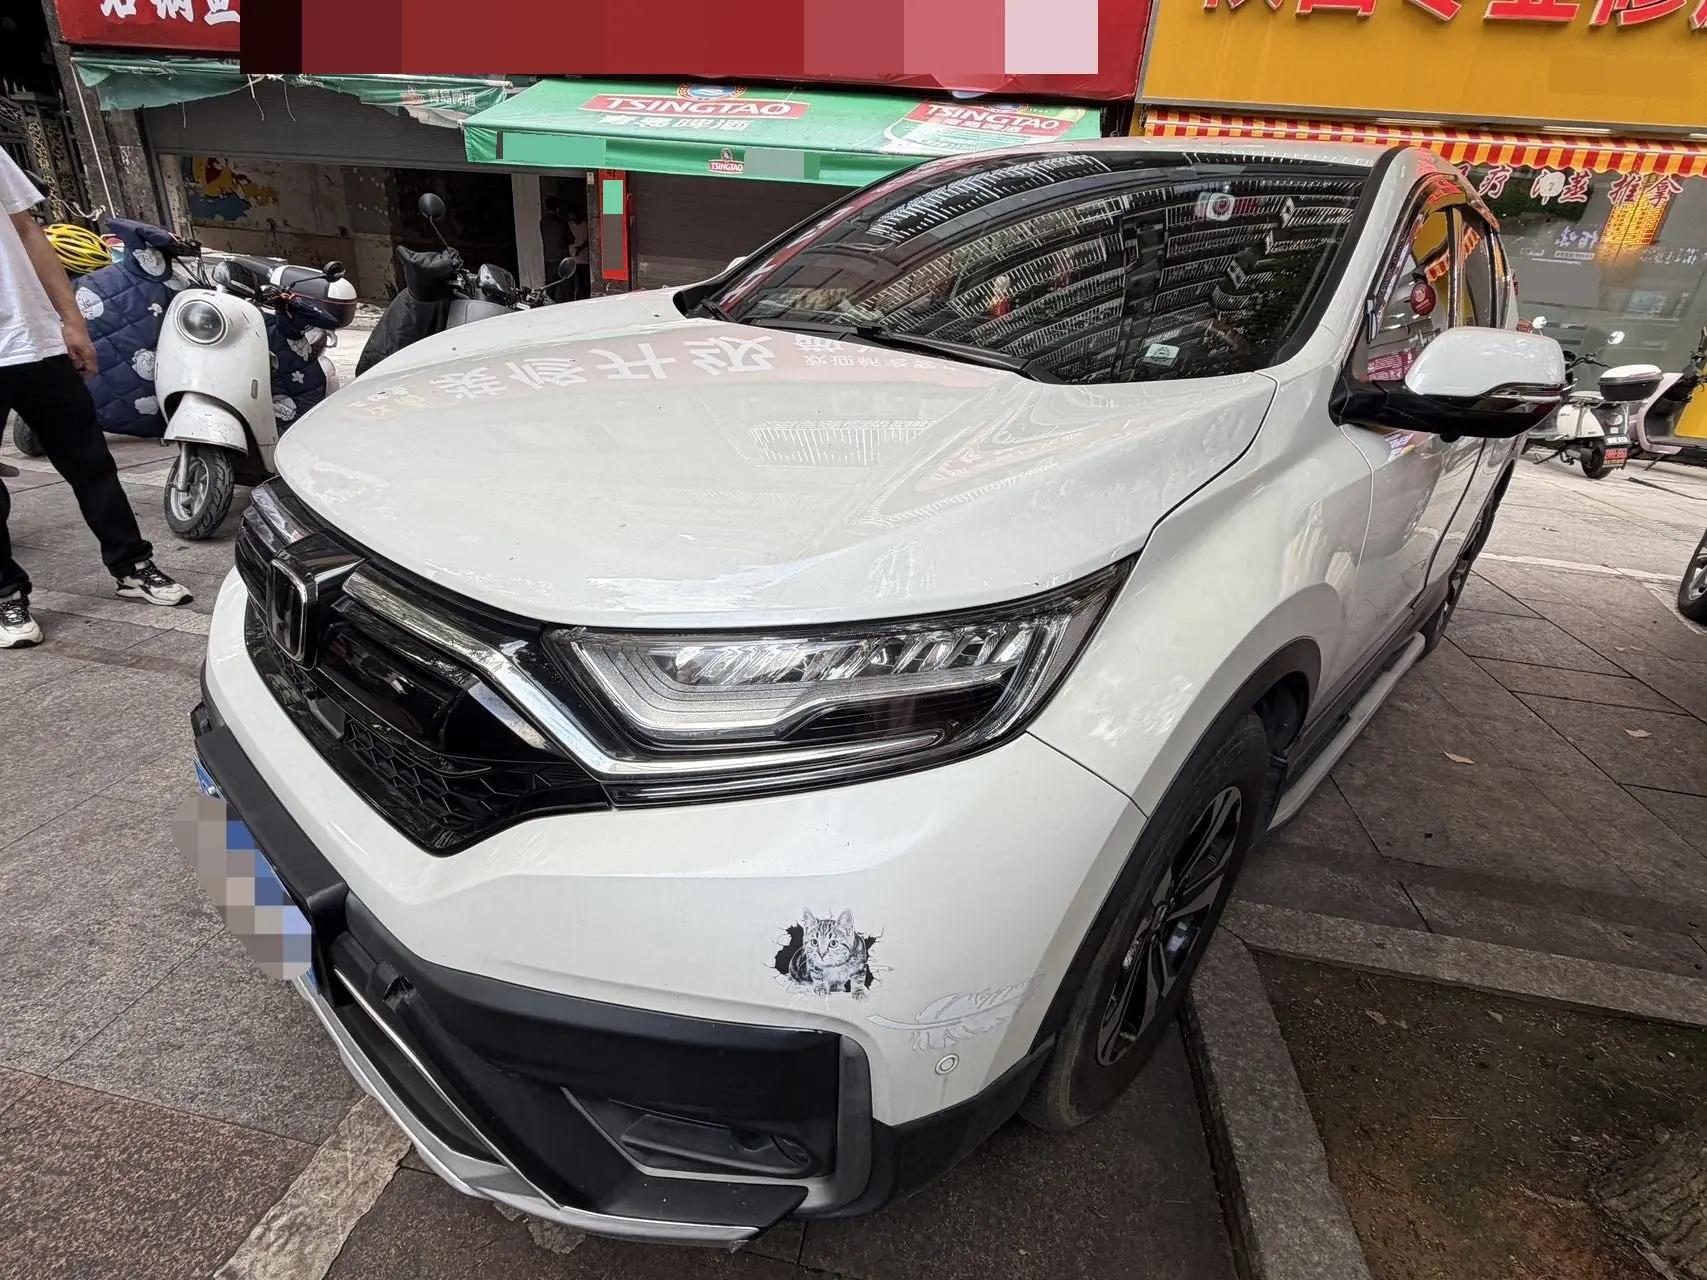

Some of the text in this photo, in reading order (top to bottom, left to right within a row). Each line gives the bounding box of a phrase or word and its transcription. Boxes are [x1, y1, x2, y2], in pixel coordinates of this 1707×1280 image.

[603, 97, 791, 116] TSINGTAO
[926, 103, 1060, 130] TSINGTAO
[711, 162, 744, 172] TSINGTAO
[1607, 172, 1684, 208] 推拿
